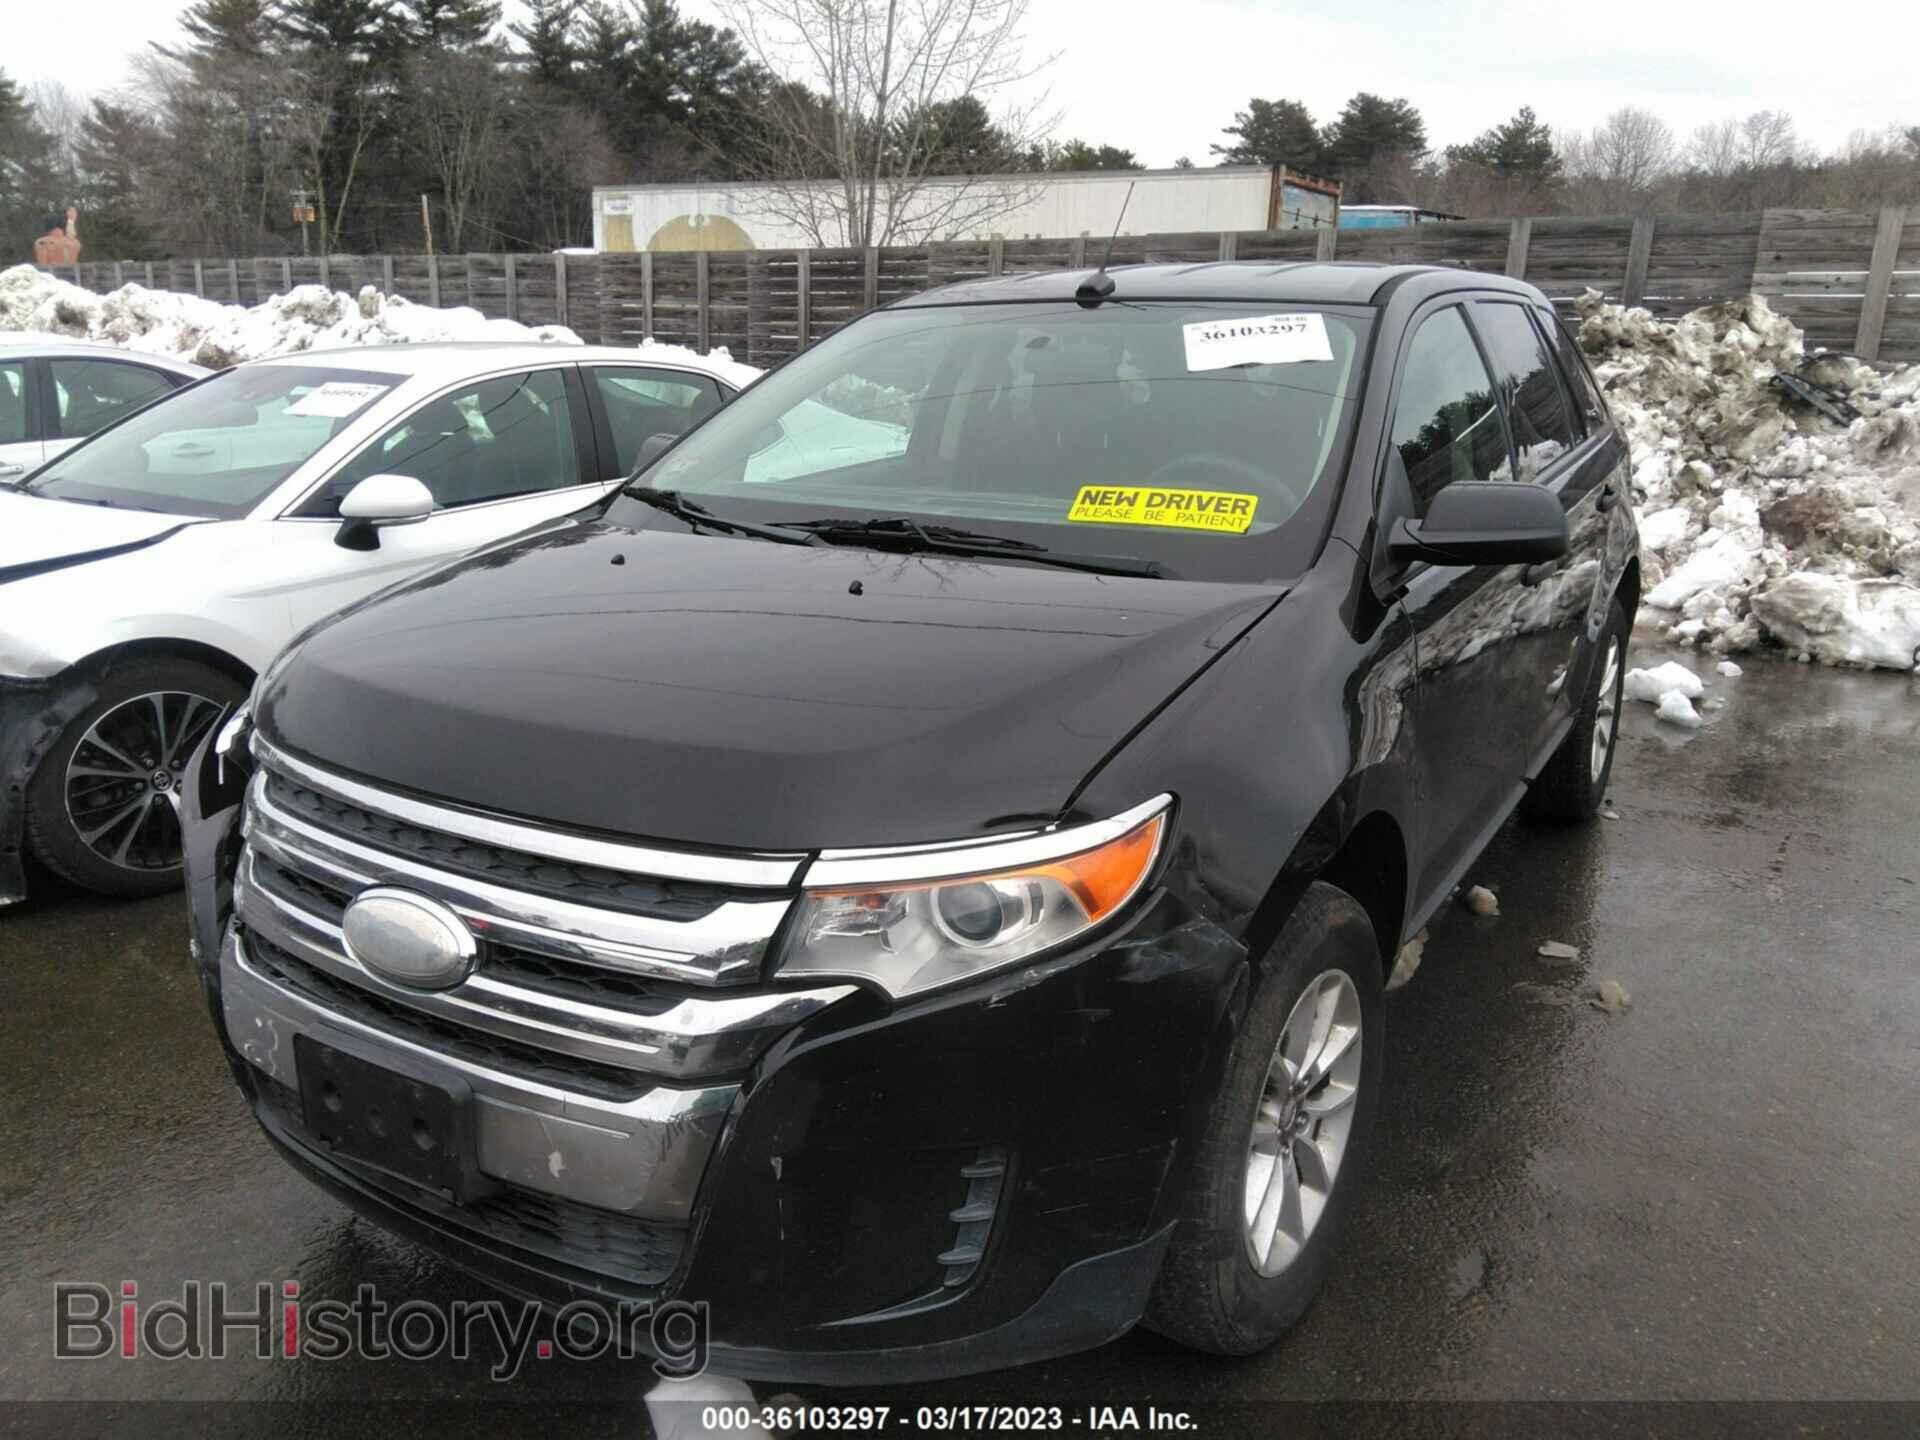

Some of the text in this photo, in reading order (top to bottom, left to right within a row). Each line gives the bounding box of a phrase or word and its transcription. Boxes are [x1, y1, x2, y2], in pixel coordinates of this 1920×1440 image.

[1200, 323, 1307, 343] 36103297
[1079, 490, 1251, 516] NEW DRIVER
[1074, 506, 1248, 529] PLEASE BE PATIENT
